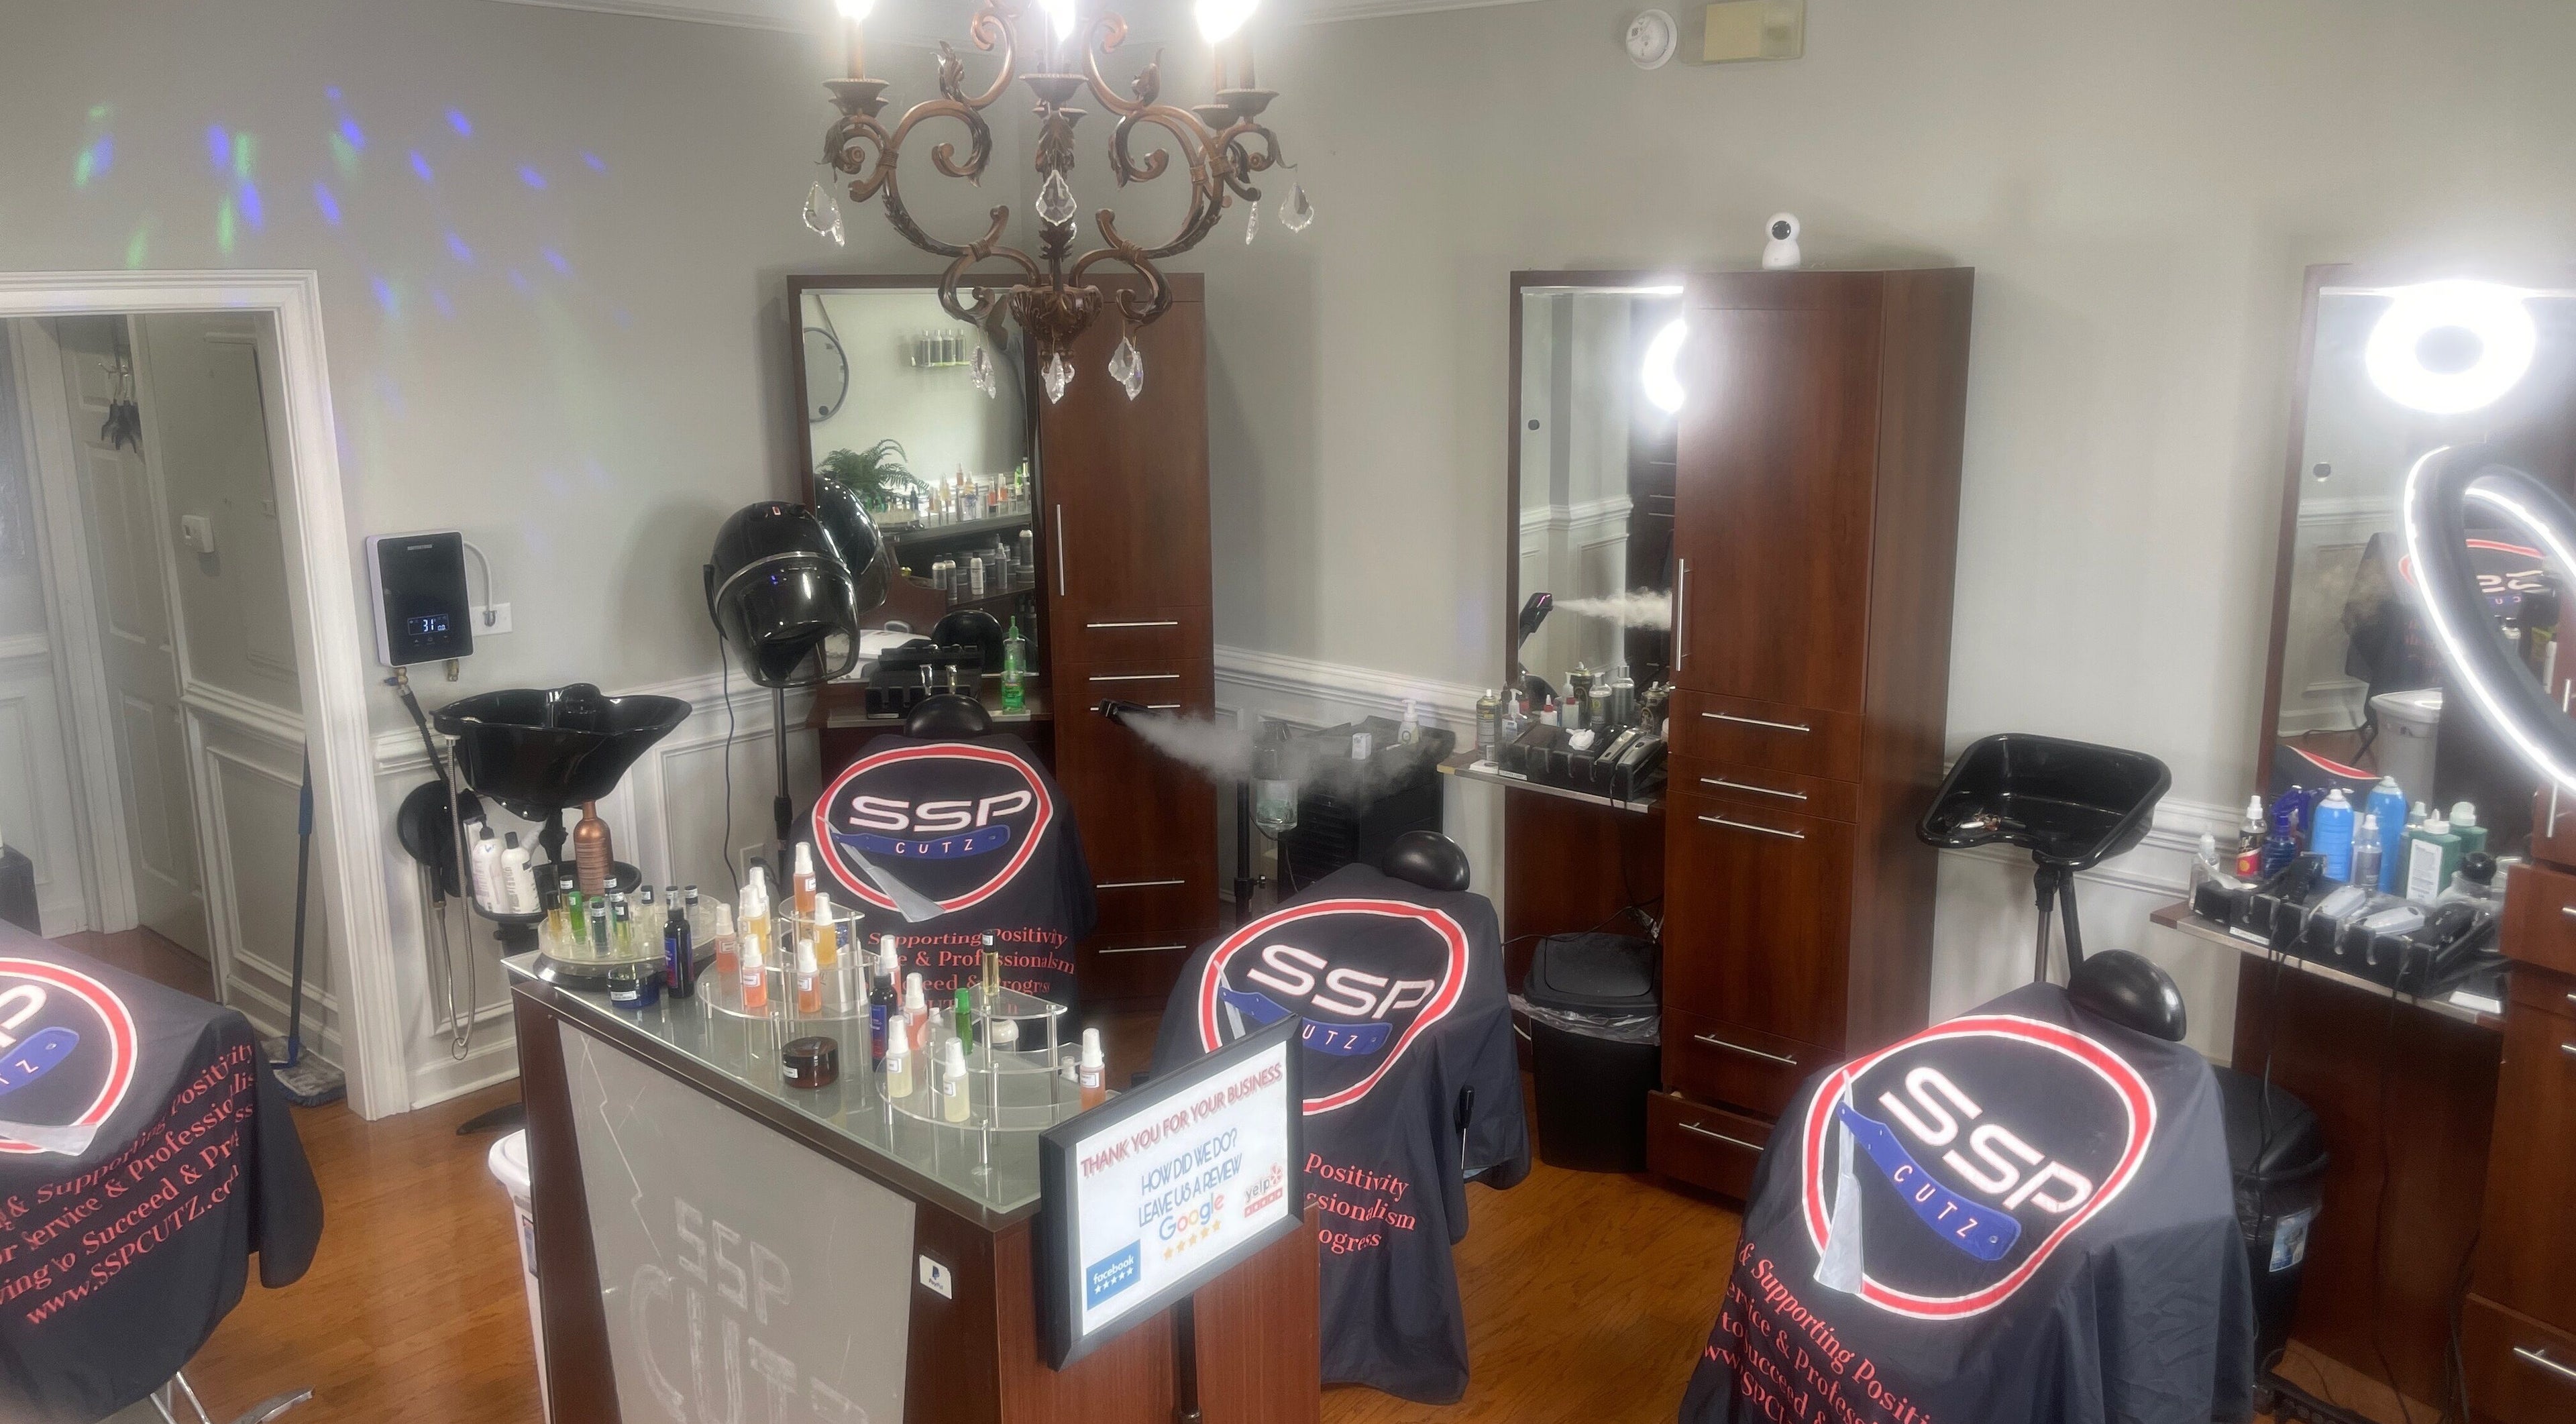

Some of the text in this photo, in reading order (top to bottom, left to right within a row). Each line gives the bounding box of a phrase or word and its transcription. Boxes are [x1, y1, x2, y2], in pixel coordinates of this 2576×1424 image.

[849, 790, 1032, 832] SSP
[895, 838, 973, 855] CUTZ
[868, 931, 982, 948] Spporting
[916, 951, 931, 966] &
[1247, 944, 1435, 1019] SSP
[1303, 1024, 1358, 1050] UTZ
[1081, 1062, 1282, 1177] THANK YOU FOR YOUR BUSINESS
[1879, 1066, 2093, 1213] SSP
[1142, 1128, 1237, 1195] HOW DID WE DO?
[1304, 1152, 1409, 1201] Positivity
[83, 1177, 180, 1255] Succeed
[180, 1164, 202, 1185] &
[105, 1179, 129, 1198] &
[1139, 1153, 1242, 1227] LEAVE US A REVIEW
[1246, 1179, 1270, 1203] yelp
[1893, 1164, 1980, 1240] CUTZ
[1159, 1193, 1224, 1240] Google
[674, 1196, 792, 1325] SSP
[1093, 1254, 1134, 1284] facebook
[1722, 1310, 1743, 1337] to
[1750, 1258, 1856, 1374] Supporting
[1776, 1330, 1790, 1359] &
